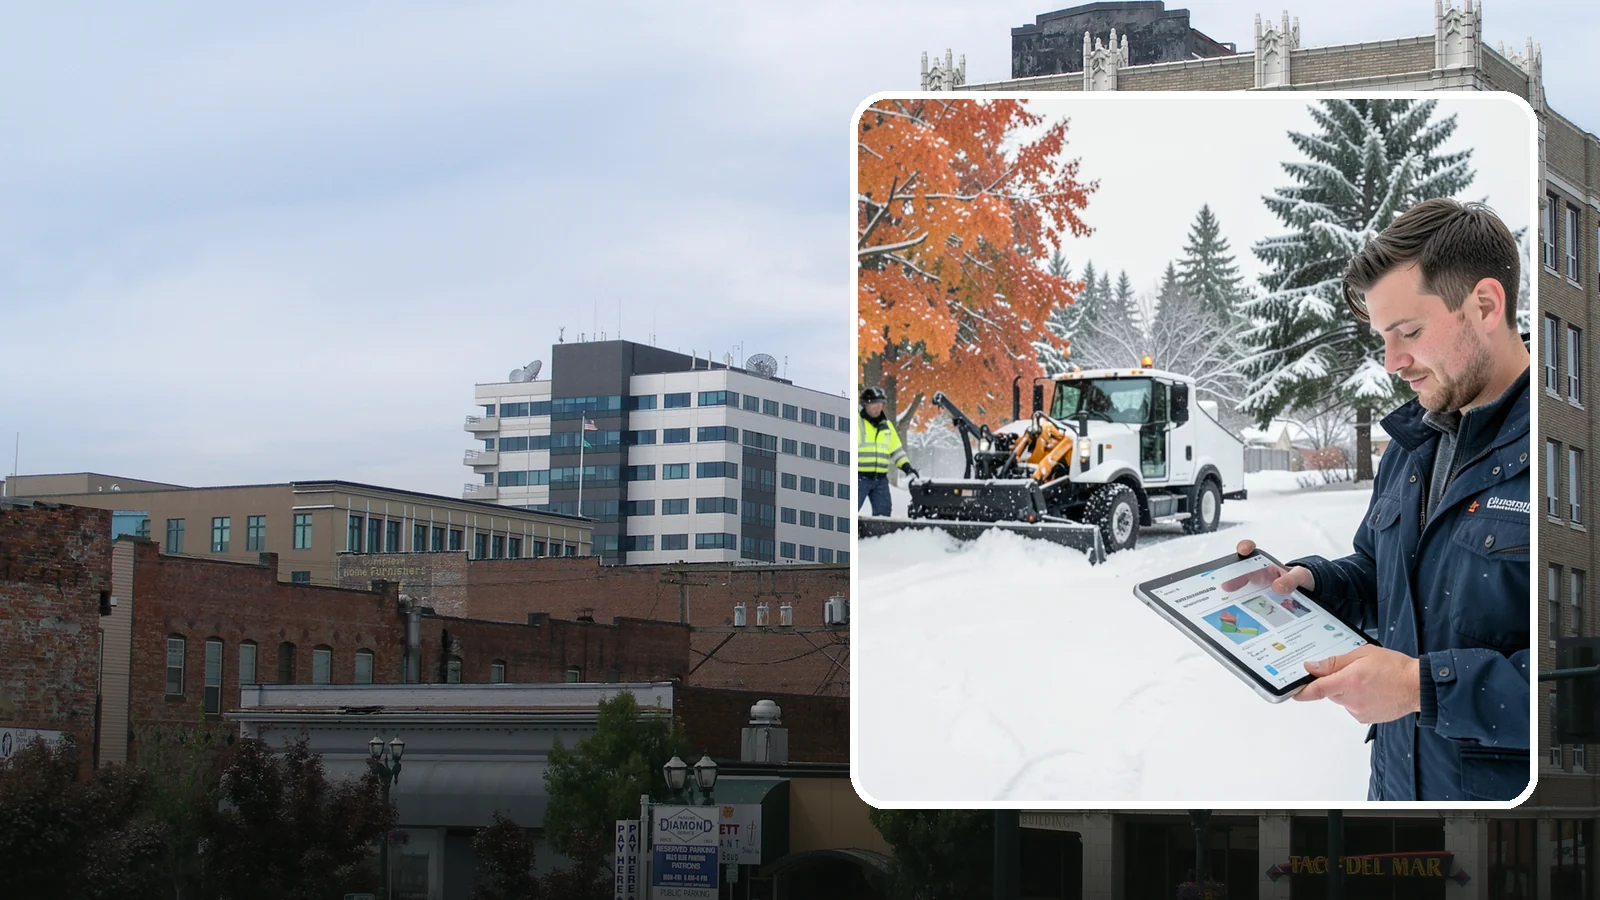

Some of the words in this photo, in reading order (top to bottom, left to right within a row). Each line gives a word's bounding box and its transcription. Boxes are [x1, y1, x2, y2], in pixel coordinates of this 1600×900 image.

[343, 568, 368, 577] Home
[370, 566, 427, 576] Furnishers
[660, 818, 713, 833] DIAMOND
[1021, 815, 1070, 828] BUILDING
[617, 825, 625, 852] PAY
[628, 824, 637, 852] PAY
[655, 845, 688, 853] RESERVED
[721, 852, 739, 862] Soup
[671, 862, 701, 870] PATRONS
[1346, 856, 1386, 876] DEL
[1391, 857, 1442, 877] MAR
[616, 856, 625, 893] HERE
[627, 856, 636, 893] HERE
[660, 888, 682, 897] PUBLIC
[683, 889, 710, 898] PARKING
